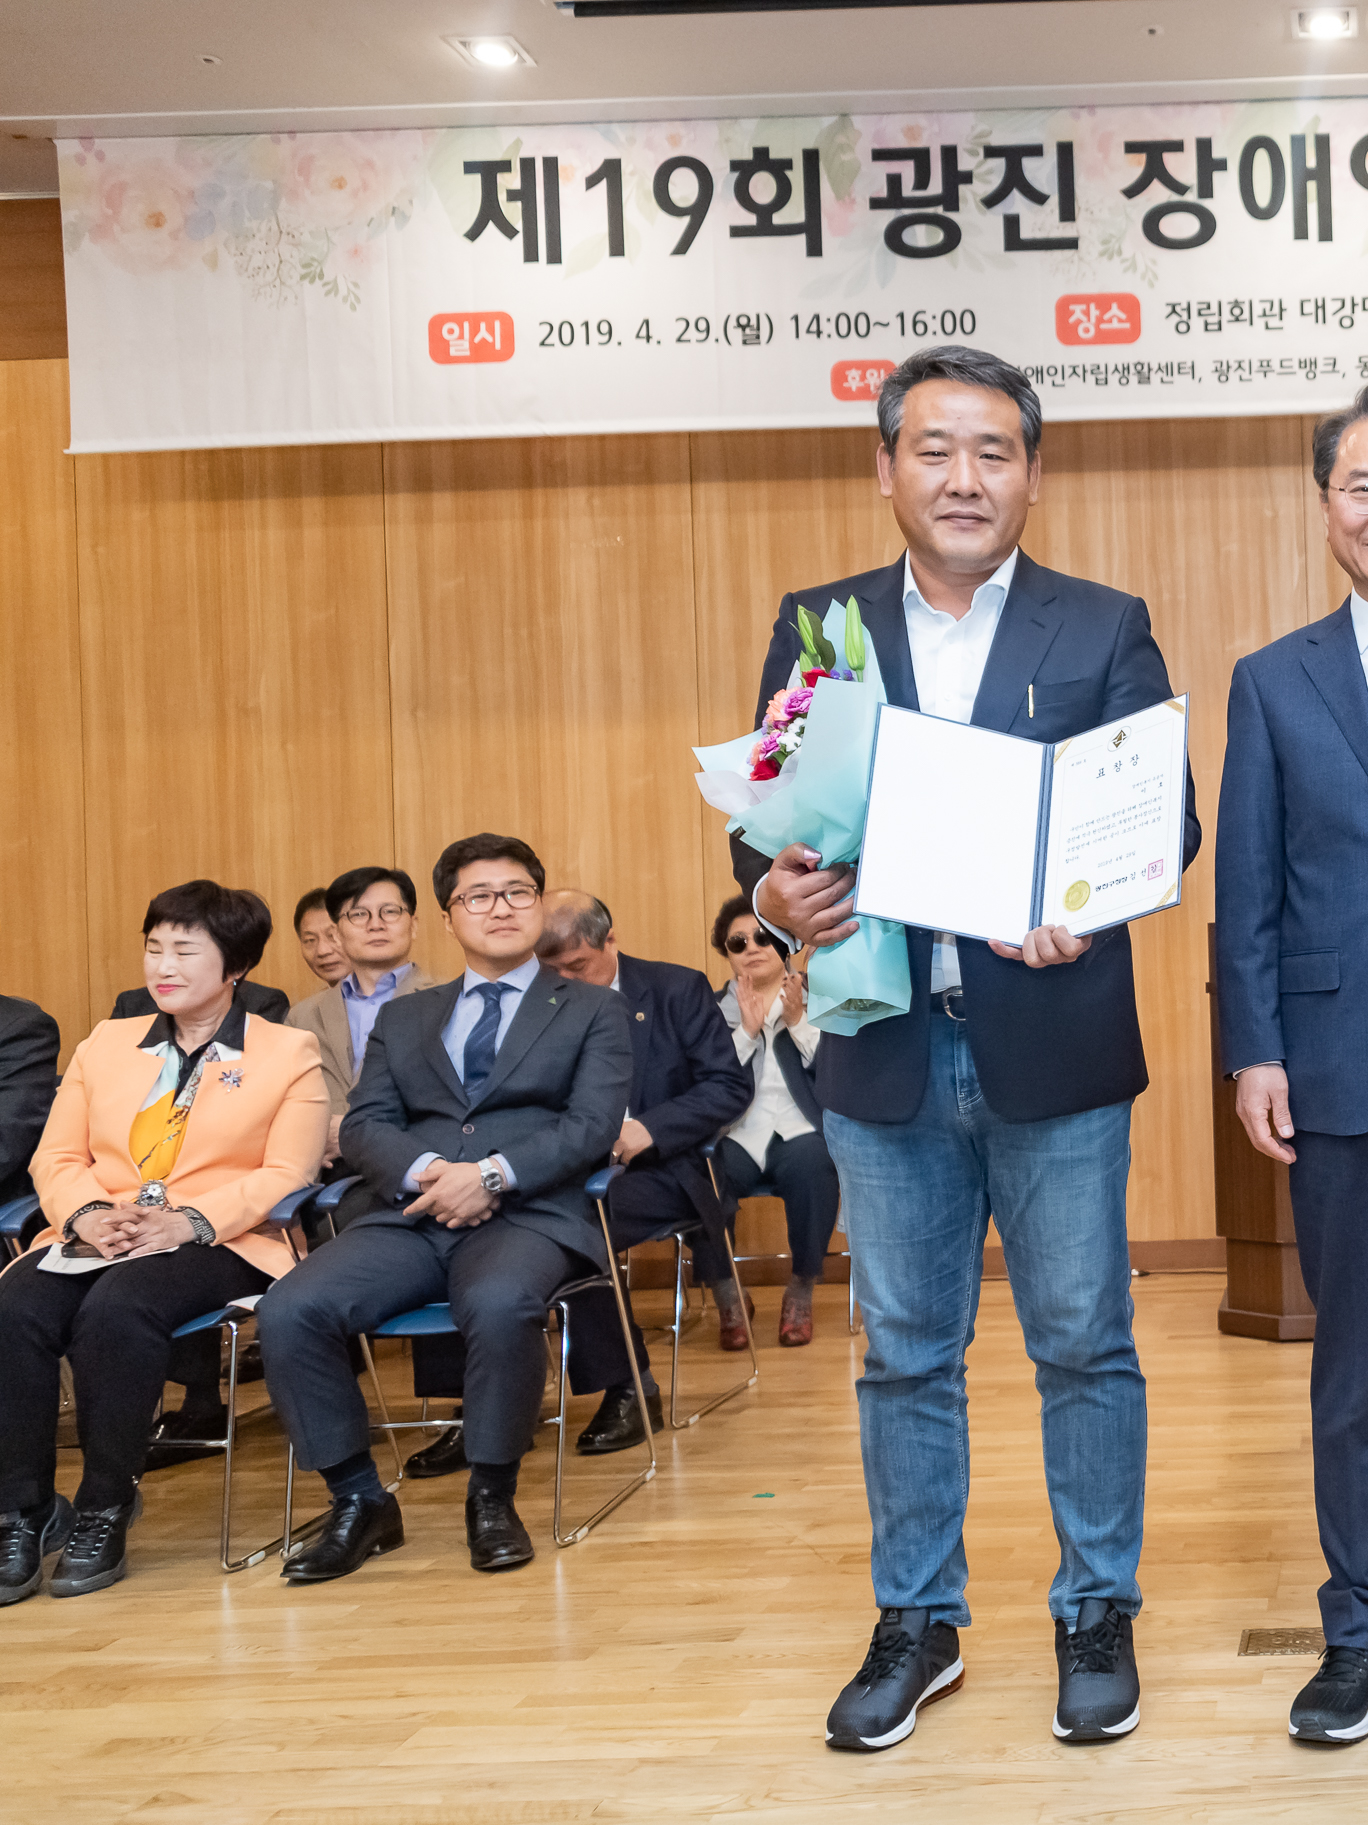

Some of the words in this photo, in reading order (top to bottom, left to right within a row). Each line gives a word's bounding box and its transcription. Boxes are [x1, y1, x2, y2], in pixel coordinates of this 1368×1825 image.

[463, 147, 823, 265] 제19회
[868, 141, 1079, 259] 광진
[442, 320, 501, 356] 일시
[538, 320, 623, 348] 2019.
[635, 318, 662, 345] 4.
[674, 313, 774, 346] 29.(월)
[789, 309, 977, 340] 14:00~16:00
[1068, 302, 1131, 340] 장소
[1164, 299, 1287, 335] 정립회관
[1017, 359, 1202, 388] 애인자립생활센터,
[1211, 356, 1347, 384] 광진푸드뱅크,
